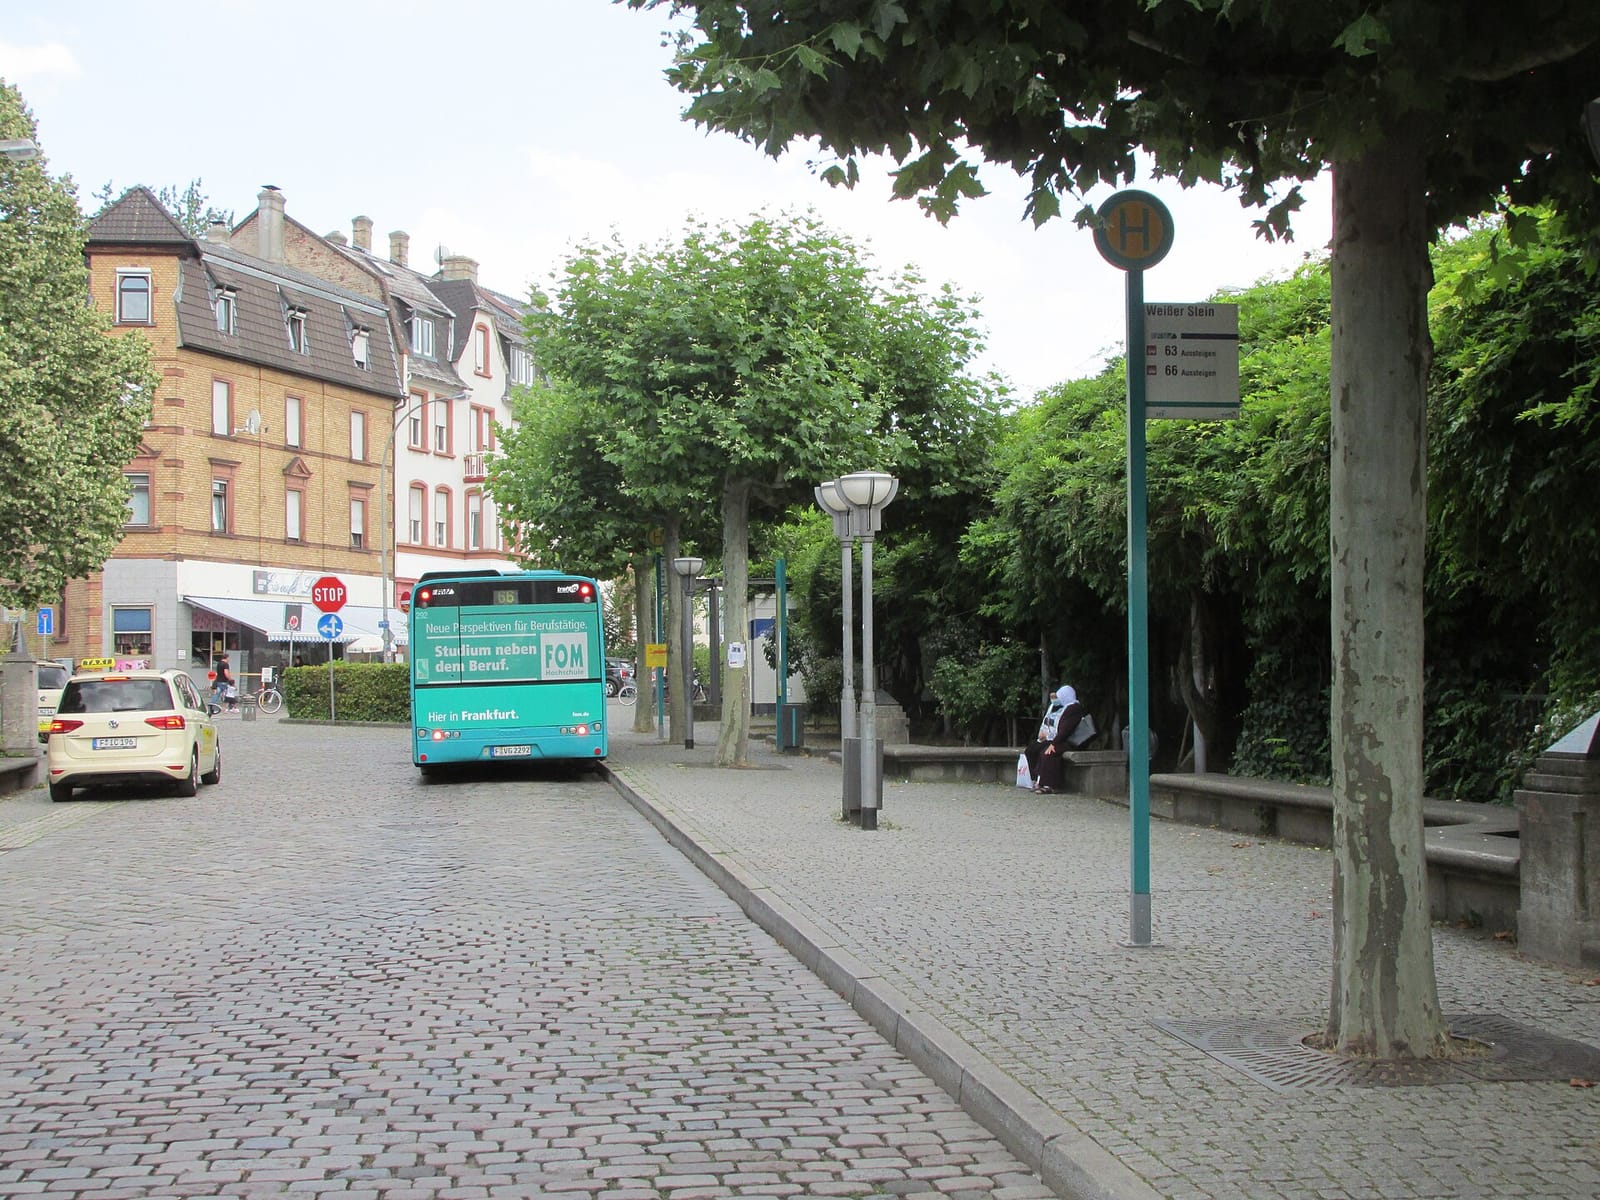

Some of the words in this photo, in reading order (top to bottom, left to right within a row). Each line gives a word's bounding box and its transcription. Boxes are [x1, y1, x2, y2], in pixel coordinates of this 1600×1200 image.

[1119, 208, 1150, 251] H
[1146, 305, 1184, 317] Weißer
[1187, 305, 1215, 317] Stein
[1164, 345, 1178, 357] 63
[1181, 350, 1217, 358] Aussteigen
[1164, 365, 1178, 376] 66
[1181, 369, 1217, 378] Aussteigen
[314, 587, 344, 602] STOP
[497, 592, 514, 604] 66
[426, 623, 450, 633] Neue
[453, 621, 511, 636] Perspektiven
[514, 619, 528, 631] für
[530, 618, 588, 632] Berufstätige.
[435, 644, 491, 657] Studium
[495, 643, 538, 656] neben
[545, 643, 584, 668] FOM
[435, 660, 465, 673] dem
[468, 658, 510, 672] Beruf.
[545, 668, 585, 676] Hochschule
[428, 711, 447, 722] Hier
[449, 711, 459, 721] in
[461, 709, 520, 721] Frankfurt.
